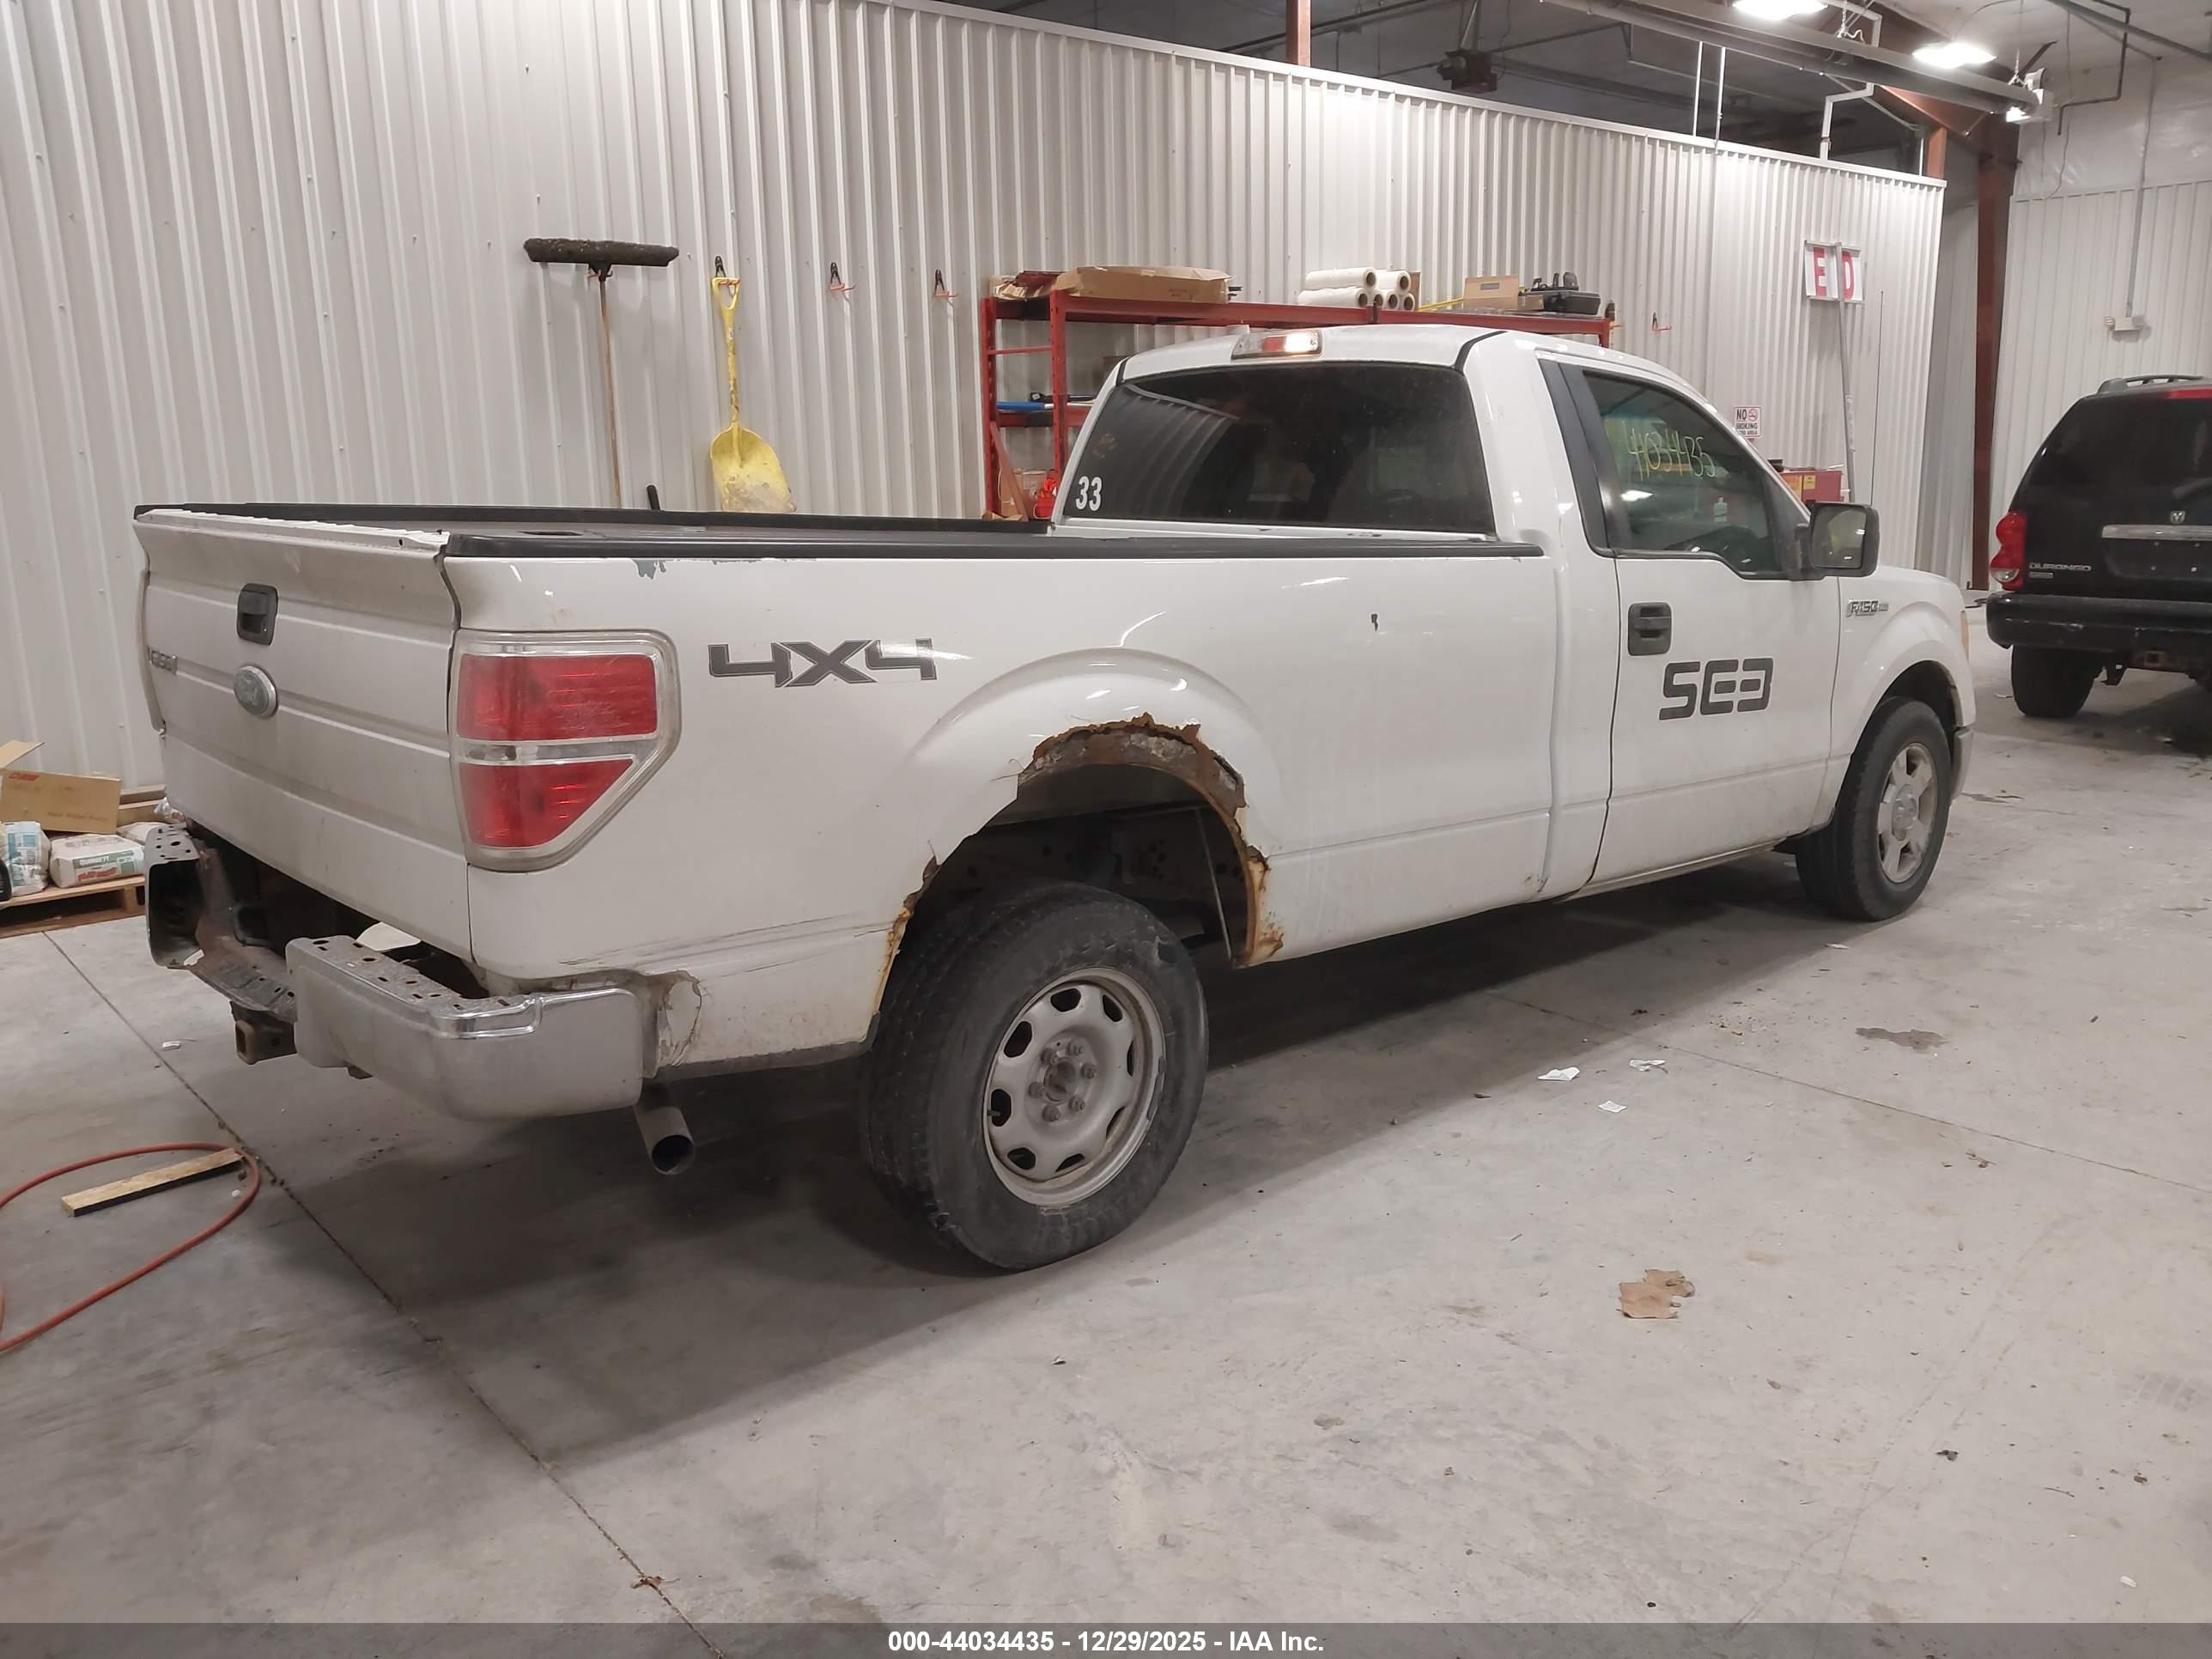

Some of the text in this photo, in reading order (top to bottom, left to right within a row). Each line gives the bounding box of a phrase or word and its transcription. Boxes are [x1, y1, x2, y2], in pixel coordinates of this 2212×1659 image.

[1813, 246, 1827, 297] E
[1736, 409, 1747, 421] NO
[1076, 476, 1103, 512] 33
